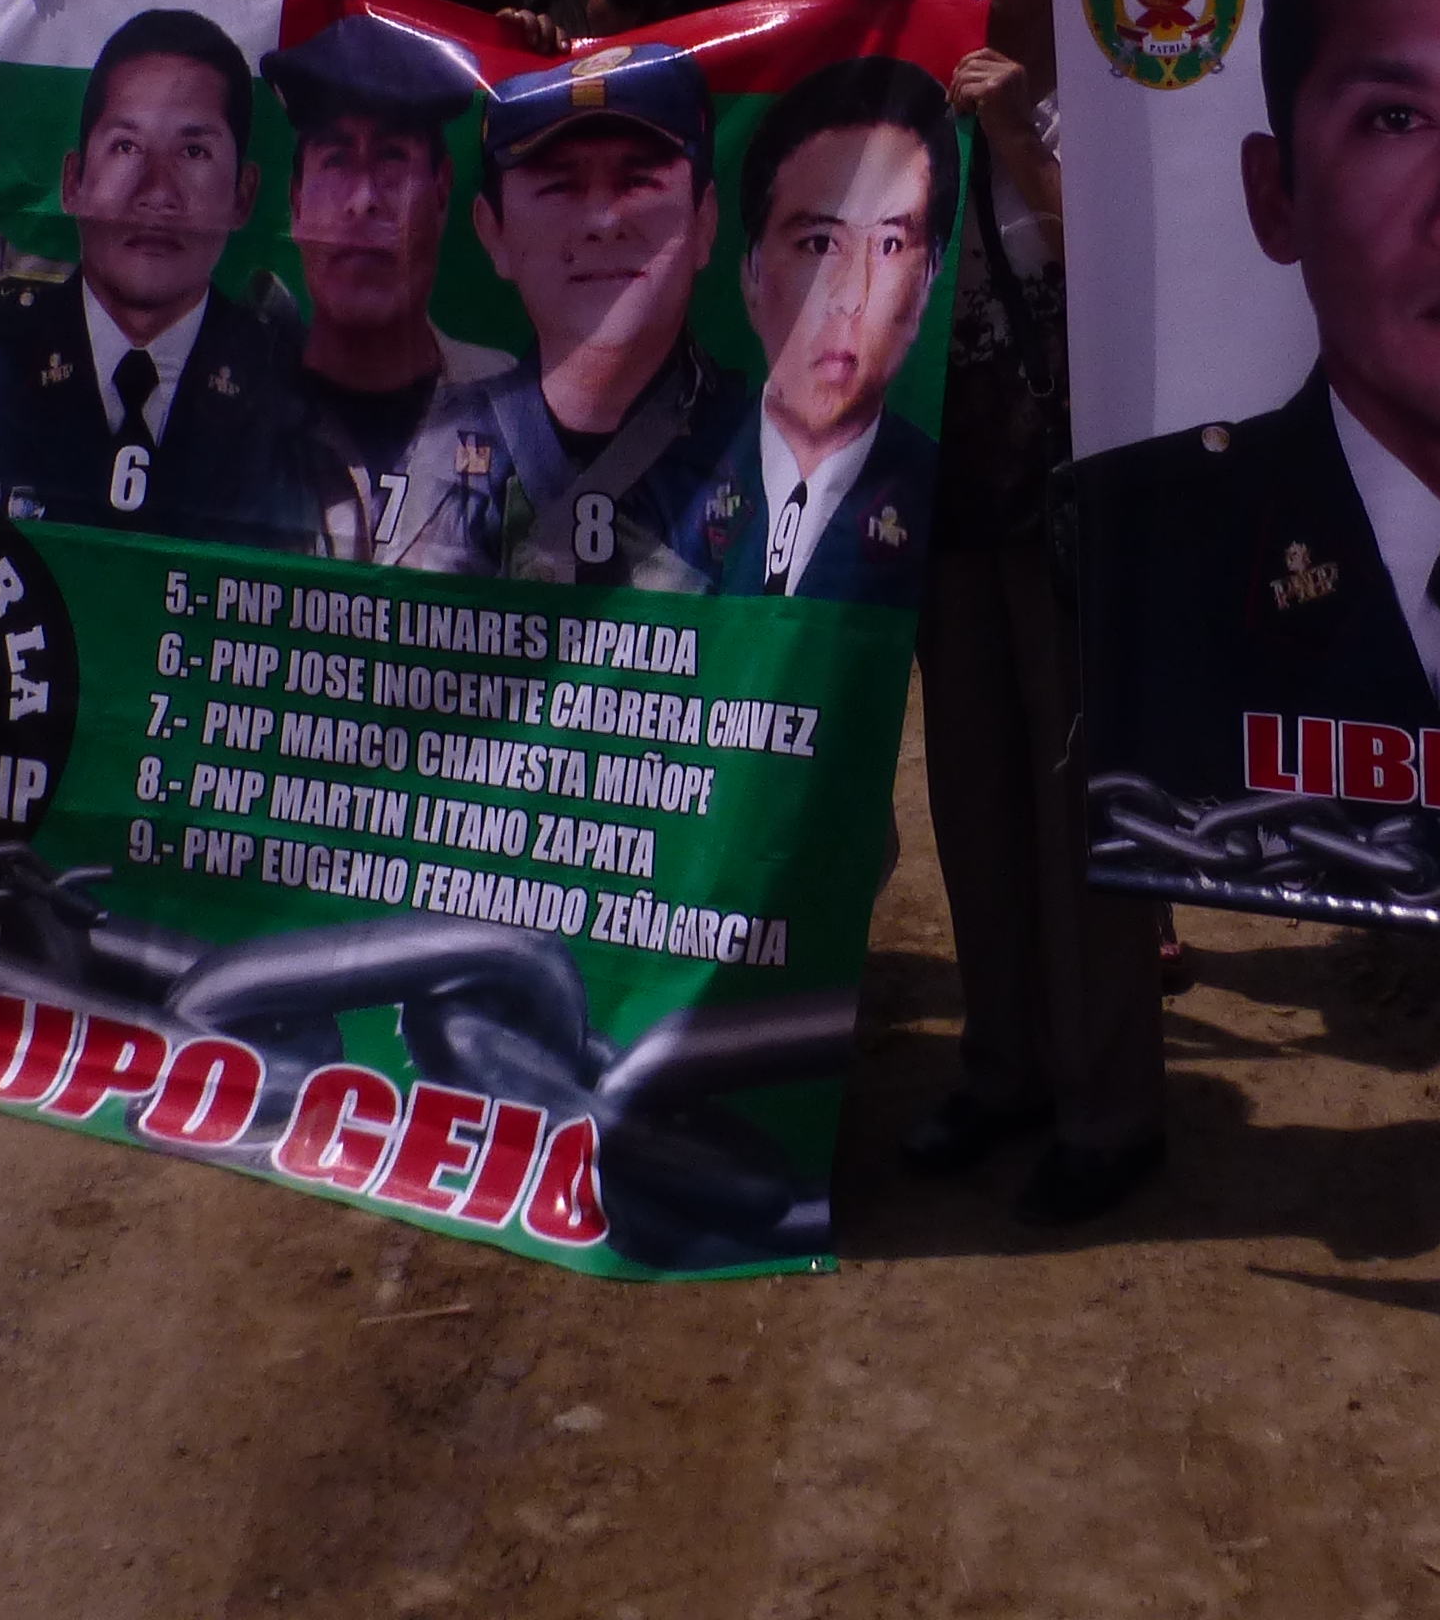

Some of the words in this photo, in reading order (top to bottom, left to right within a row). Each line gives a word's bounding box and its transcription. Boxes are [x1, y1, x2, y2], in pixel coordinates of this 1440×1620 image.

[108, 442, 152, 512] 6
[373, 473, 409, 546] 7
[571, 491, 618, 565] 8
[765, 500, 804, 576] 9
[4, 624, 50, 722] LA
[215, 576, 283, 628] PNP
[287, 586, 391, 644] JORGE
[397, 599, 549, 663] LINARES
[557, 616, 701, 679] RIPALDA
[209, 638, 281, 690] PNP
[284, 649, 367, 704] JOSE
[372, 658, 546, 728] INOCENTE
[549, 679, 702, 747] CABRERA
[706, 696, 823, 759] CHAVEZ
[201, 699, 275, 753] PNP
[278, 710, 410, 775] MARCO
[416, 729, 588, 800] CHAVESTA
[189, 761, 266, 815] PNP
[269, 772, 410, 839] MARTIN
[413, 794, 529, 859] LITANO
[530, 810, 657, 879] ZAPATA
[182, 826, 255, 878] PNP
[261, 838, 410, 906] EUGENIO
[411, 862, 587, 937] FERNANDO
